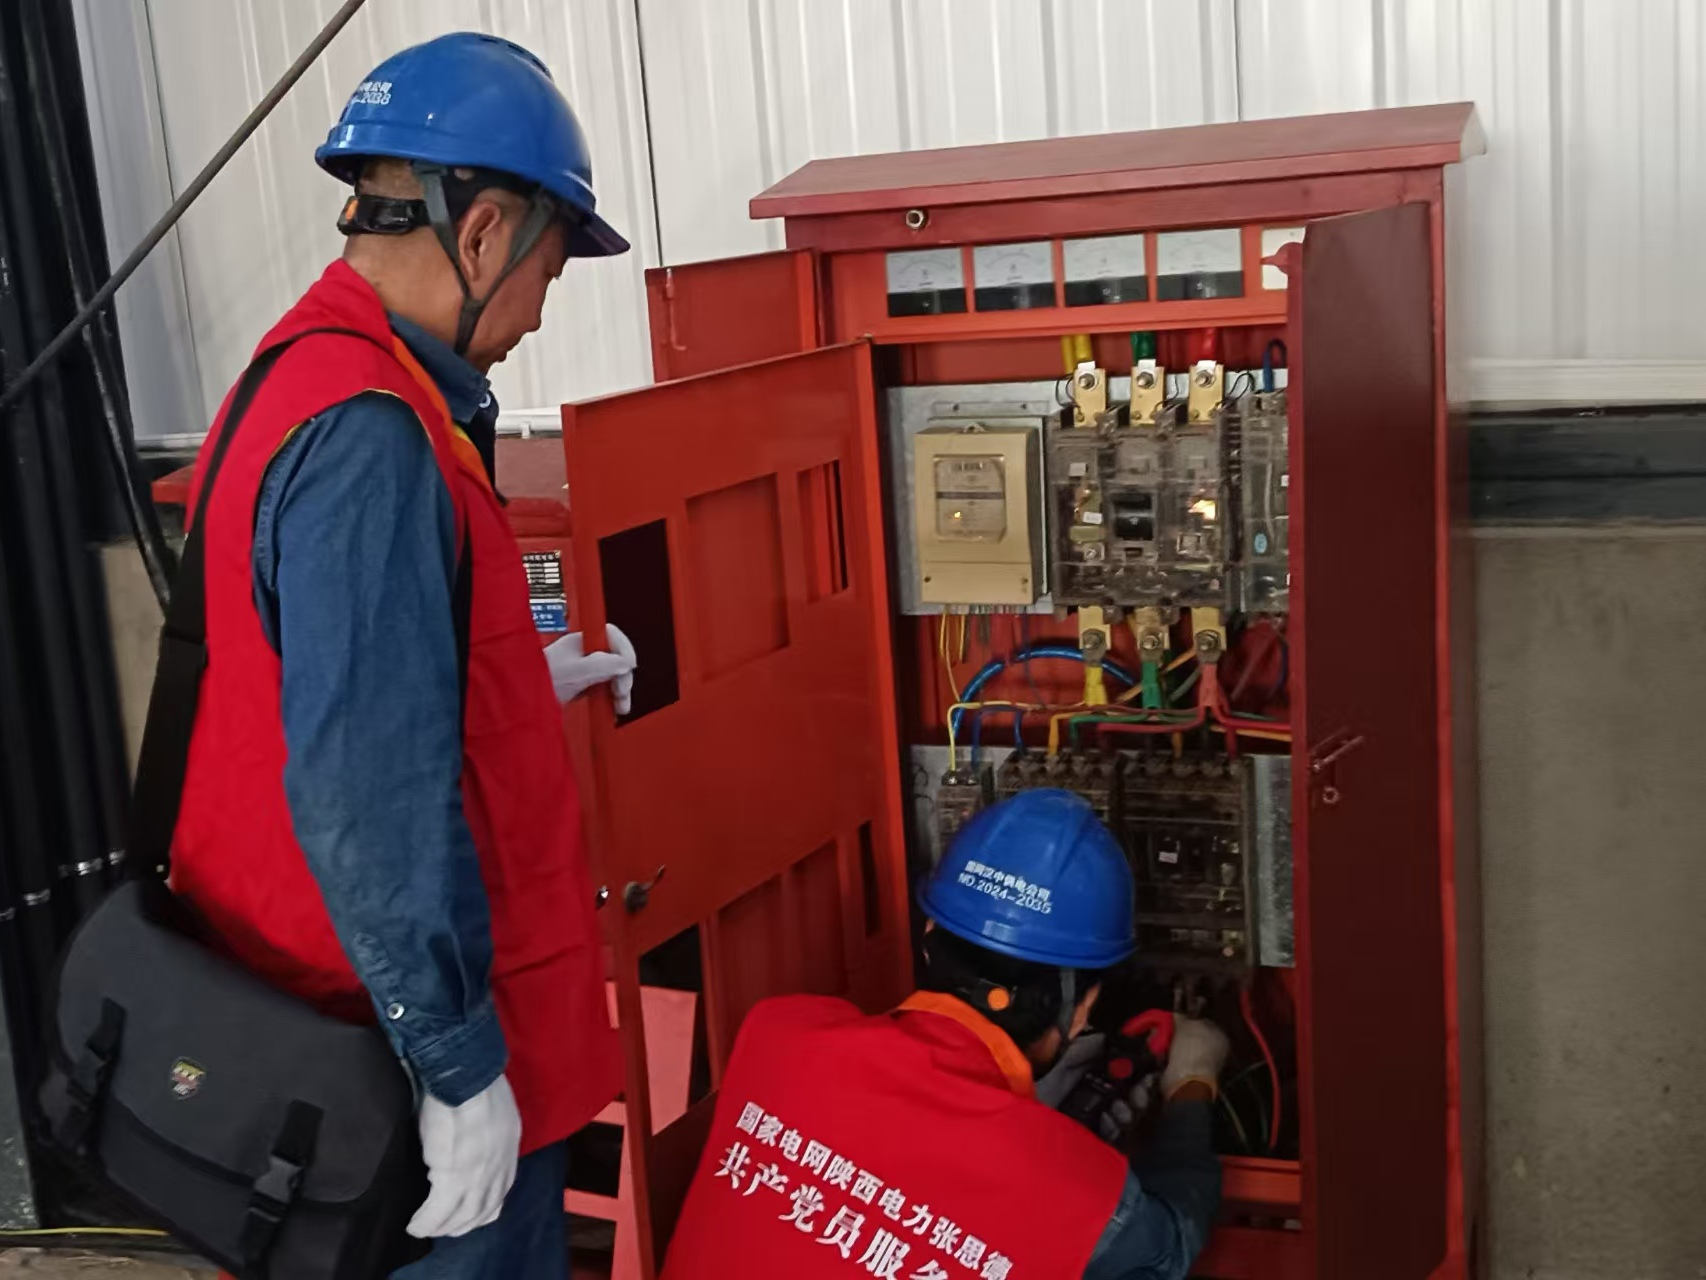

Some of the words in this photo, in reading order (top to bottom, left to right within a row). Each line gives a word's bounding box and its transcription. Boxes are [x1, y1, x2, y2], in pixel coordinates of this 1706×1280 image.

[736, 1102, 1013, 1280] 国家电网陕西电力张思德
